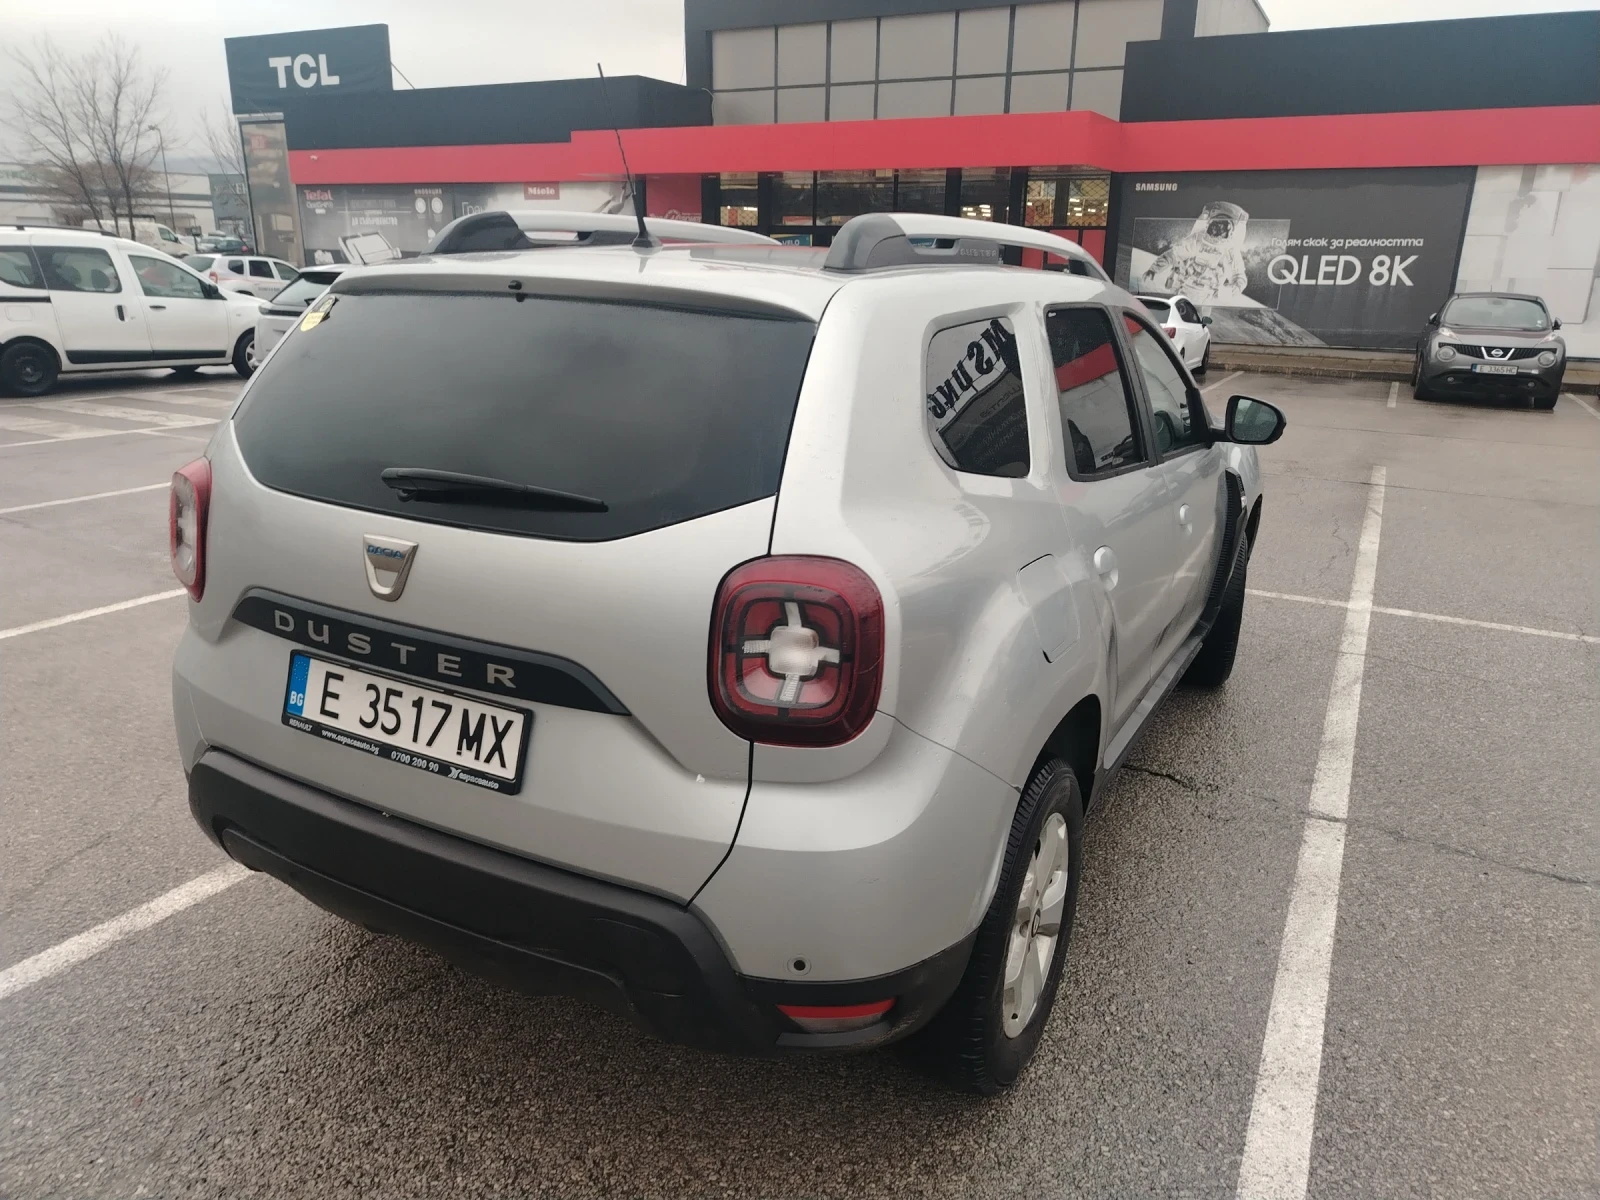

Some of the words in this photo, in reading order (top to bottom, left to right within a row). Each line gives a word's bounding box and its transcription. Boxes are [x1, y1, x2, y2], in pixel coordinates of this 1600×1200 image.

[268, 53, 340, 89] TCL
[304, 189, 334, 201] Tefal
[527, 186, 556, 196] Miele
[1135, 182, 1178, 192] SAMSUNG
[1271, 238, 1302, 247] Голям
[1303, 237, 1328, 247] скок
[1329, 238, 1344, 250] за
[1267, 254, 1362, 286] QLED
[1368, 254, 1419, 287] 8K
[367, 544, 404, 559] DACIA
[274, 609, 517, 689] DUSTER
[289, 690, 304, 707] BG
[319, 670, 345, 720] E
[289, 718, 313, 732] RENAULT
[321, 728, 380, 756] www.espaceauto.bg
[390, 750, 411, 765] 0700
[411, 756, 427, 769] 200
[428, 761, 439, 773] 90
[458, 771, 499, 790] espaceauto
